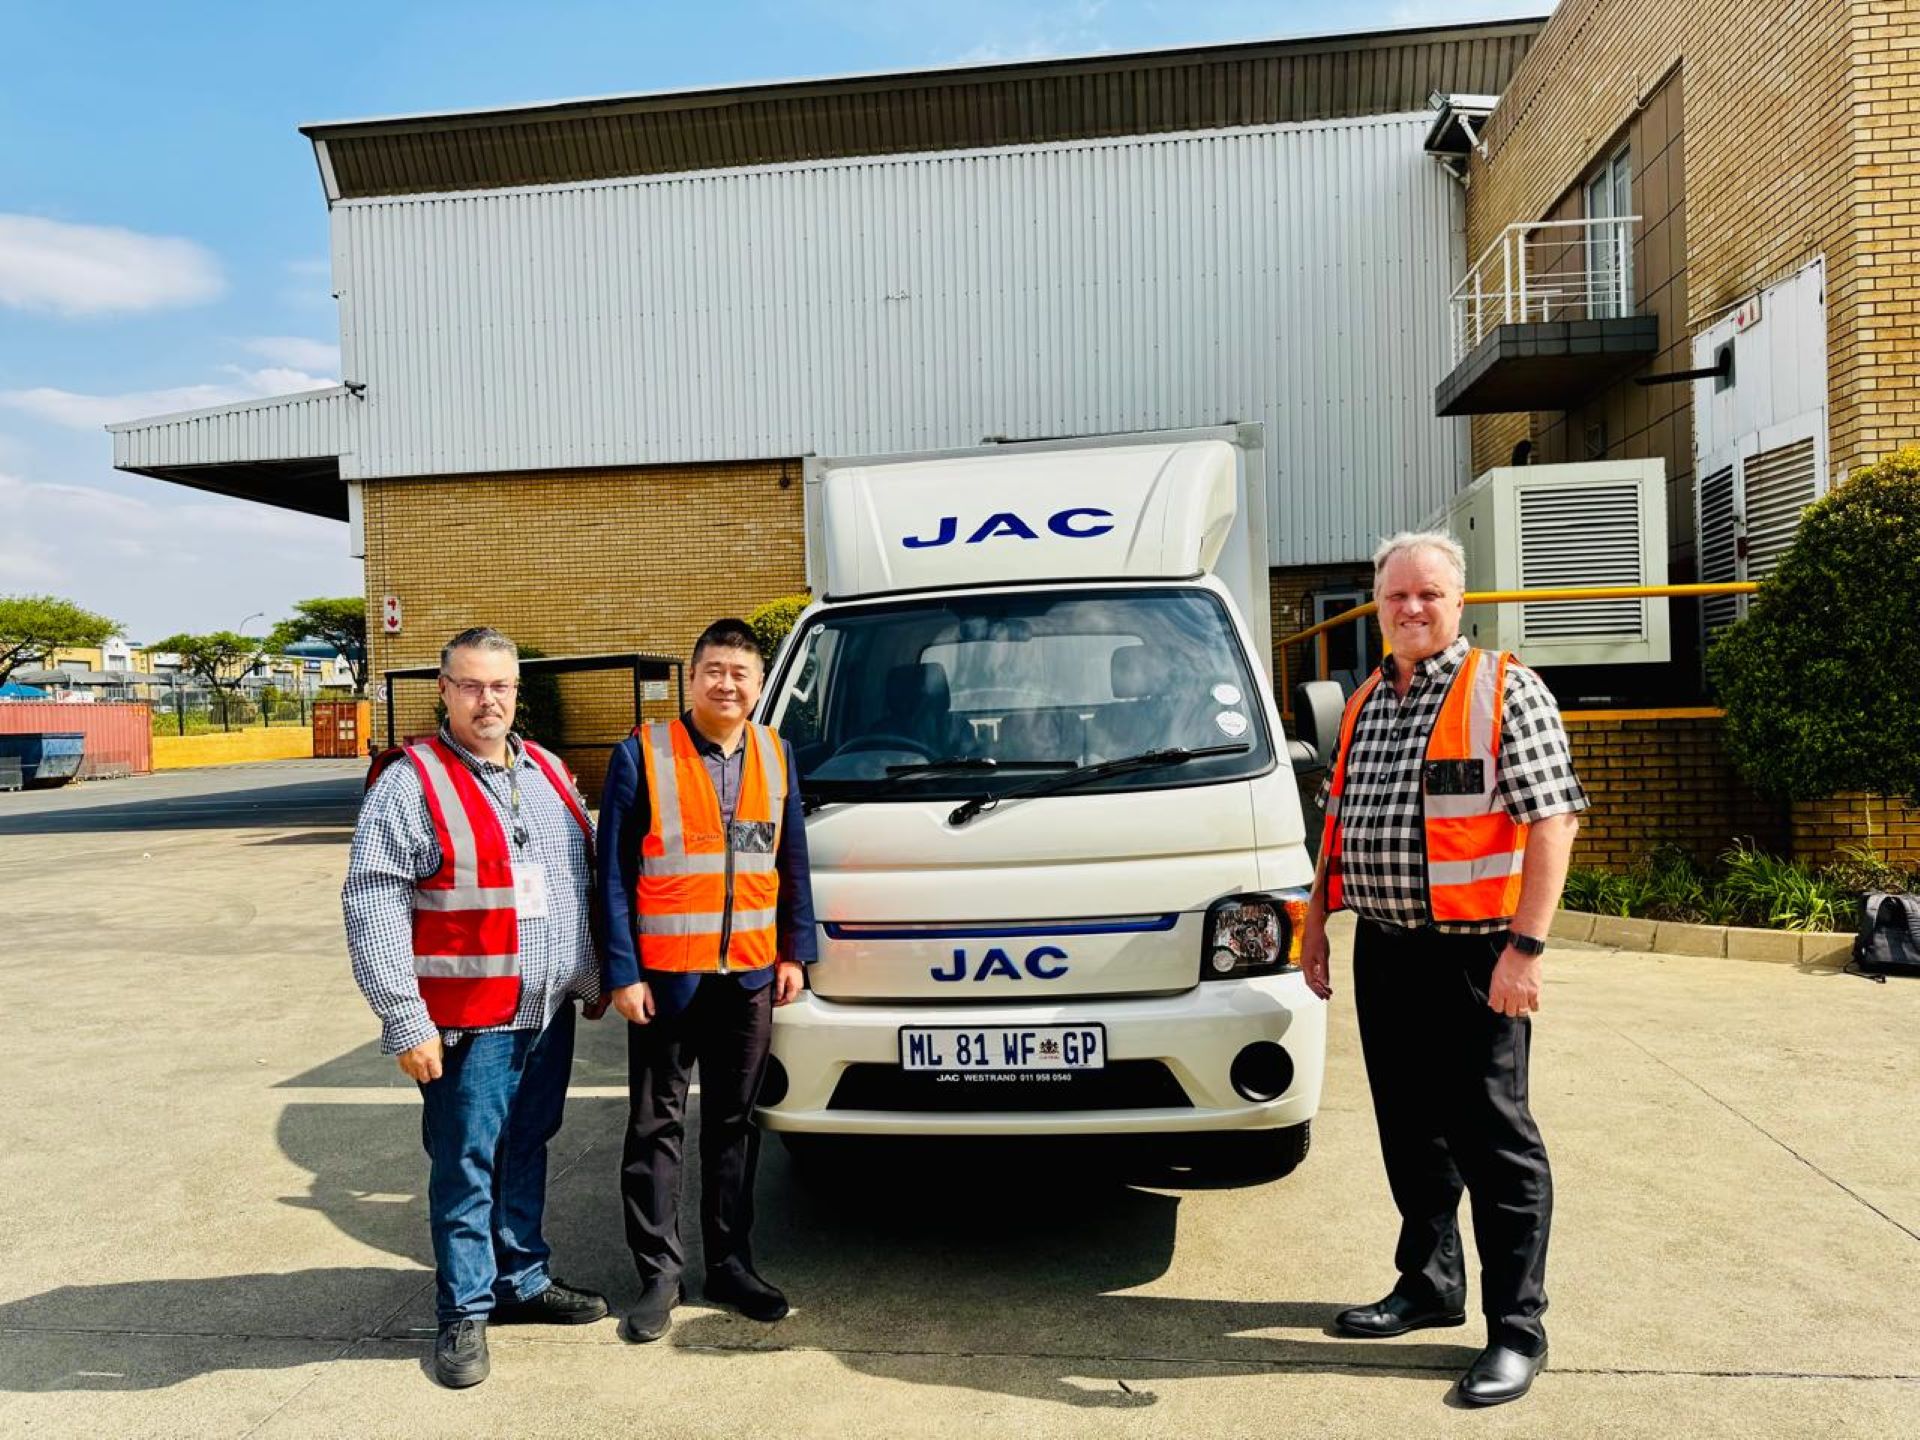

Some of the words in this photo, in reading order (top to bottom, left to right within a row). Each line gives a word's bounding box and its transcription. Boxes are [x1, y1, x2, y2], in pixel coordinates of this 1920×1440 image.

[902, 507, 1115, 549] JAC
[930, 945, 1069, 981] JAC
[909, 1033, 943, 1066] ML
[956, 1033, 989, 1065] 81
[1003, 1032, 1036, 1065] WF
[1062, 1031, 1096, 1064] GP
[936, 1074, 960, 1082] JAC
[963, 1074, 1017, 1082] WESTRAND
[1019, 1074, 1034, 1082] 011
[1052, 1074, 1072, 1082] 0540
